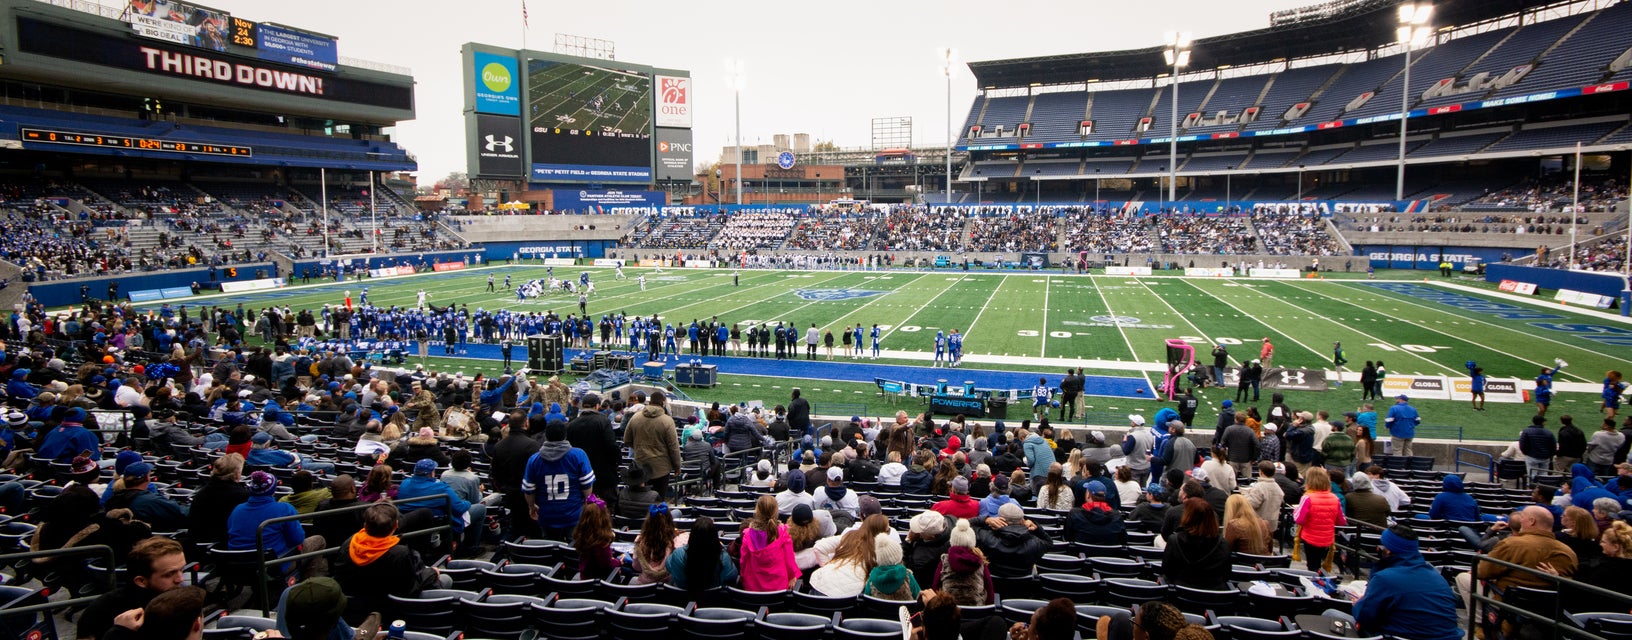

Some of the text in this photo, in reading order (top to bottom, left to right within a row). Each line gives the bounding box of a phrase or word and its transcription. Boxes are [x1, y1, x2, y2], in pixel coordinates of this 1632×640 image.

[138, 16, 162, 27] WE'RE
[162, 21, 182, 31] KIND
[234, 18, 252, 29] Nov
[160, 32, 181, 41] DEAL
[237, 28, 248, 36] 24
[234, 36, 253, 46] 2:30
[271, 36, 294, 46] GEORGIA
[275, 31, 300, 41] LARGEST
[301, 37, 330, 47] UNIVERSITY
[287, 45, 314, 56] STUDENTS
[291, 56, 336, 70] #thestateway
[140, 46, 324, 95] THIRD DOWN!
[484, 71, 508, 84] Own
[662, 106, 686, 115] one
[49, 133, 56, 141] 0
[124, 139, 130, 147] 5
[139, 139, 160, 149] 0:24
[670, 143, 691, 152] PNC
[1369, 253, 1472, 263] GEORGIA STATE
[230, 268, 237, 276] 5
[545, 474, 570, 500] 10
